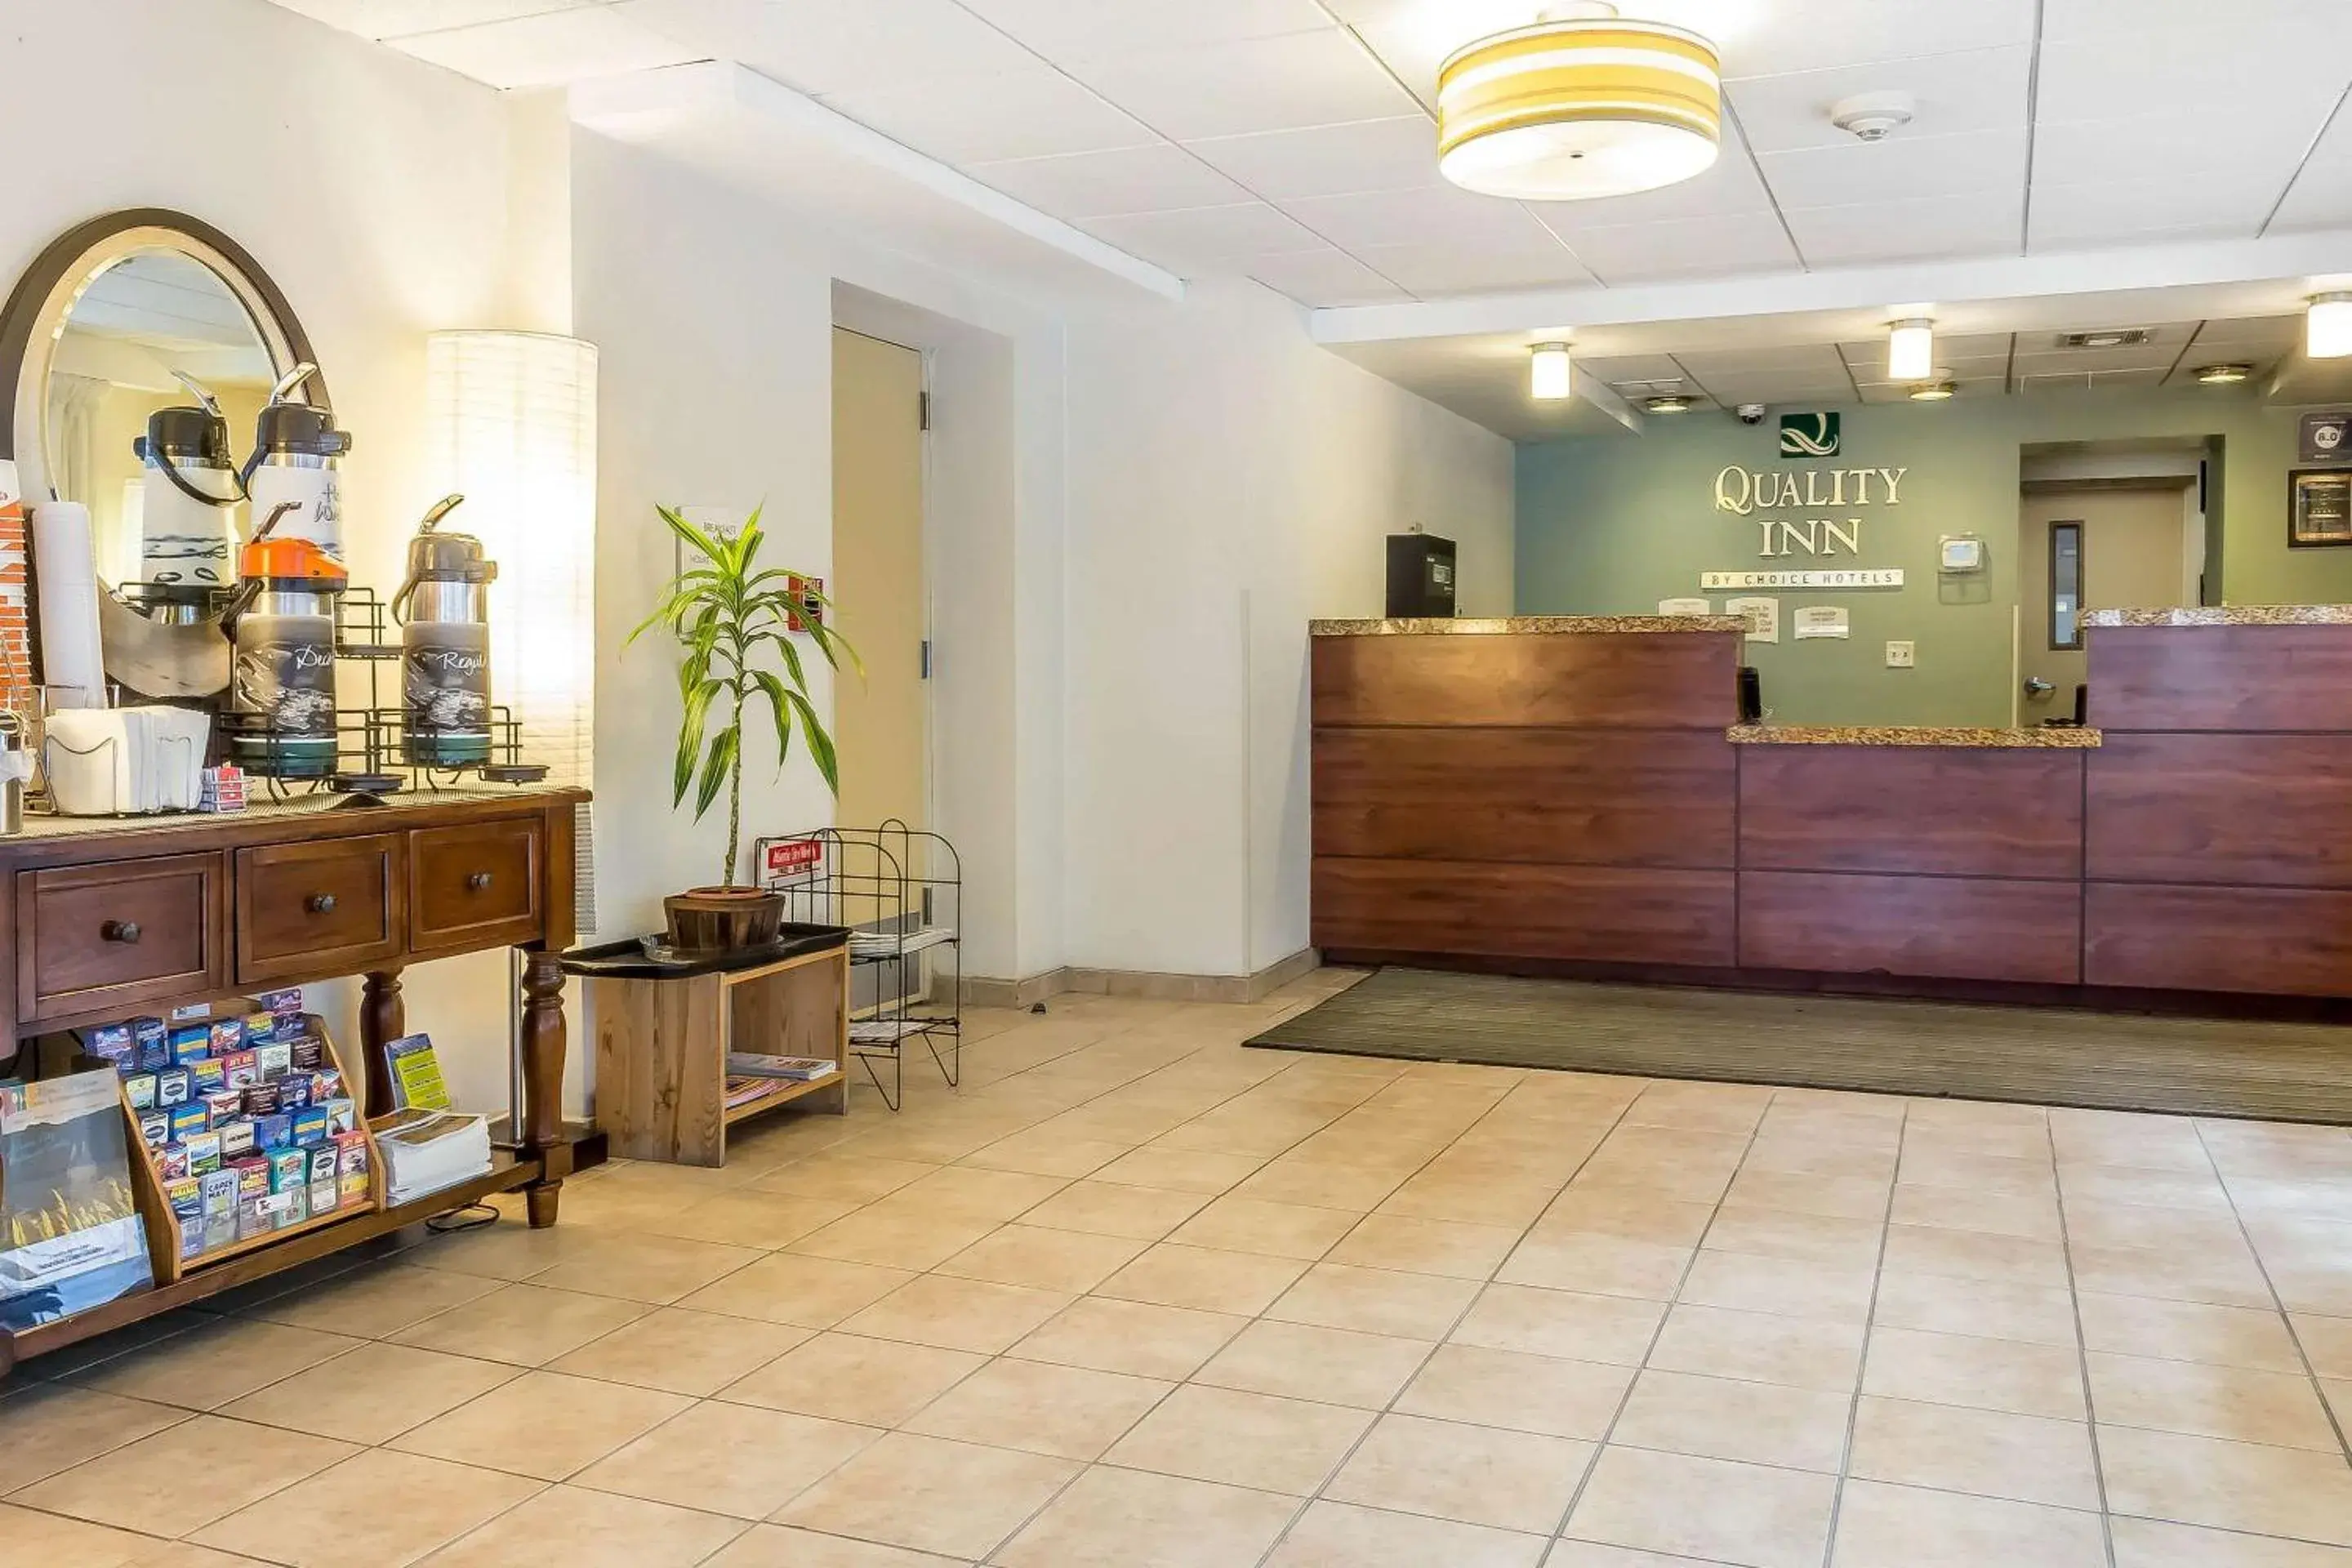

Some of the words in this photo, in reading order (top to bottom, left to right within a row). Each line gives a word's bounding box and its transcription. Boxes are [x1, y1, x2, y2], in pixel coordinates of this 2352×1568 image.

[1715, 465, 1908, 515] QUALITY
[1758, 519, 1862, 557] INN
[1711, 575, 1731, 586] BY
[1744, 573, 1811, 585] CHOICE
[1823, 572, 1893, 584] HOTELS
